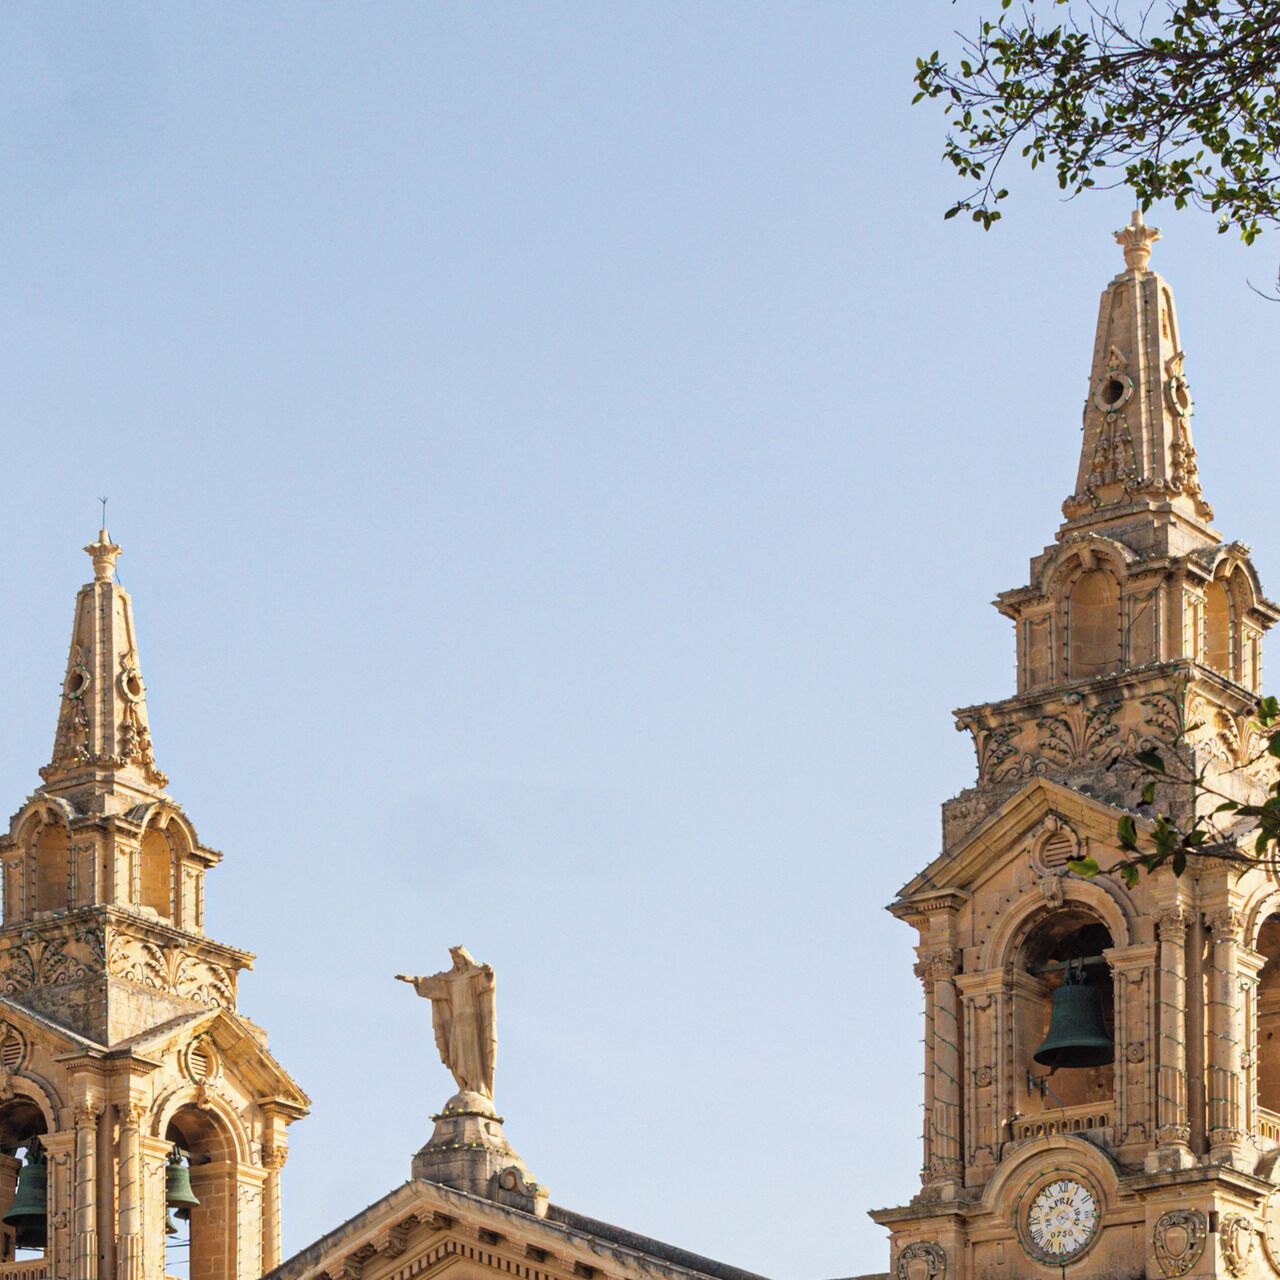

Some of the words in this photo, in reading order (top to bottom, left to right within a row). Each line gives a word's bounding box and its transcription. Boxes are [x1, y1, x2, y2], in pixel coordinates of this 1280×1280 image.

[1058, 1182, 1069, 1194] XII
[1042, 1187, 1054, 1201] XI
[1080, 1194, 1092, 1205] II
[1033, 1202, 1044, 1211] X
[1048, 1196, 1074, 1213] APRIL
[1050, 1230, 1074, 1239] 0750
